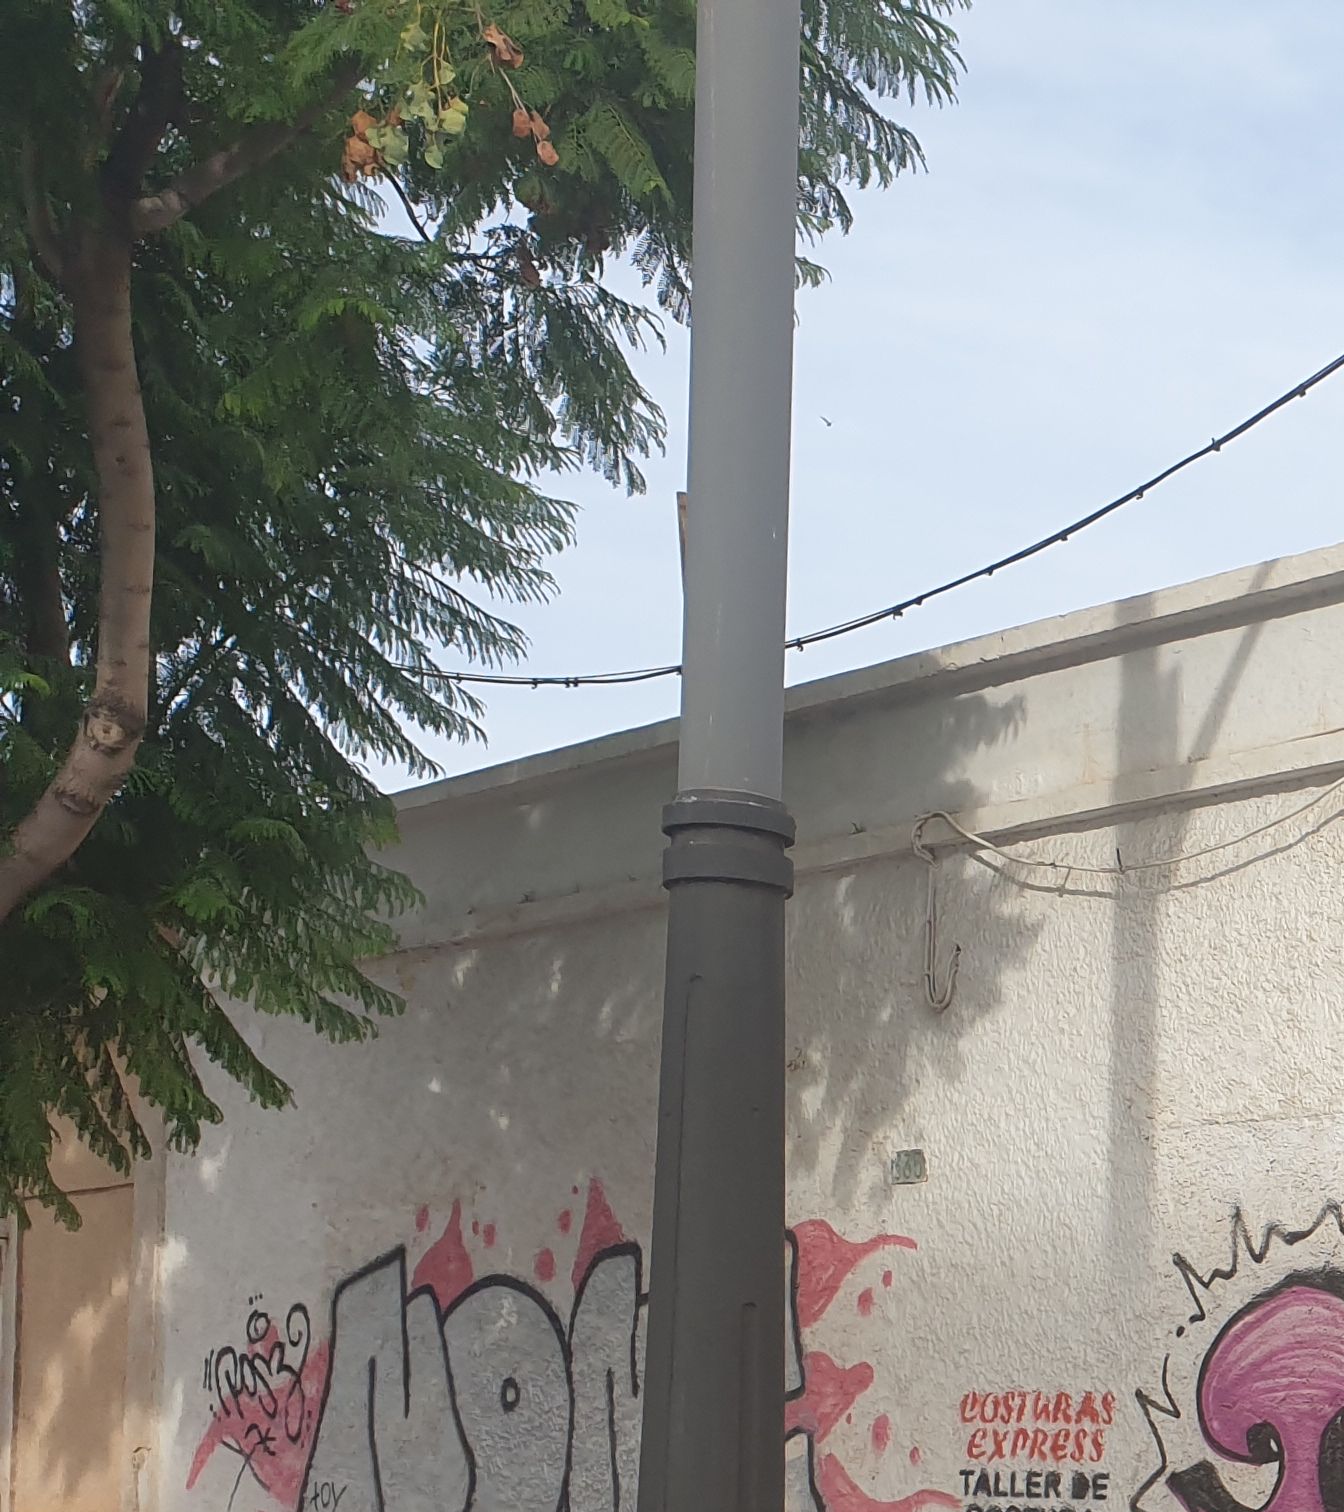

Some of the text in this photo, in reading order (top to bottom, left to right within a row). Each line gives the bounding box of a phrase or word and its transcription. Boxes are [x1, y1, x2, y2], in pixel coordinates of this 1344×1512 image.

[960, 1390, 1116, 1425] COSTURAS
[966, 1427, 1106, 1464] EXPRESS
[959, 1469, 1110, 1500] TALLER DE
